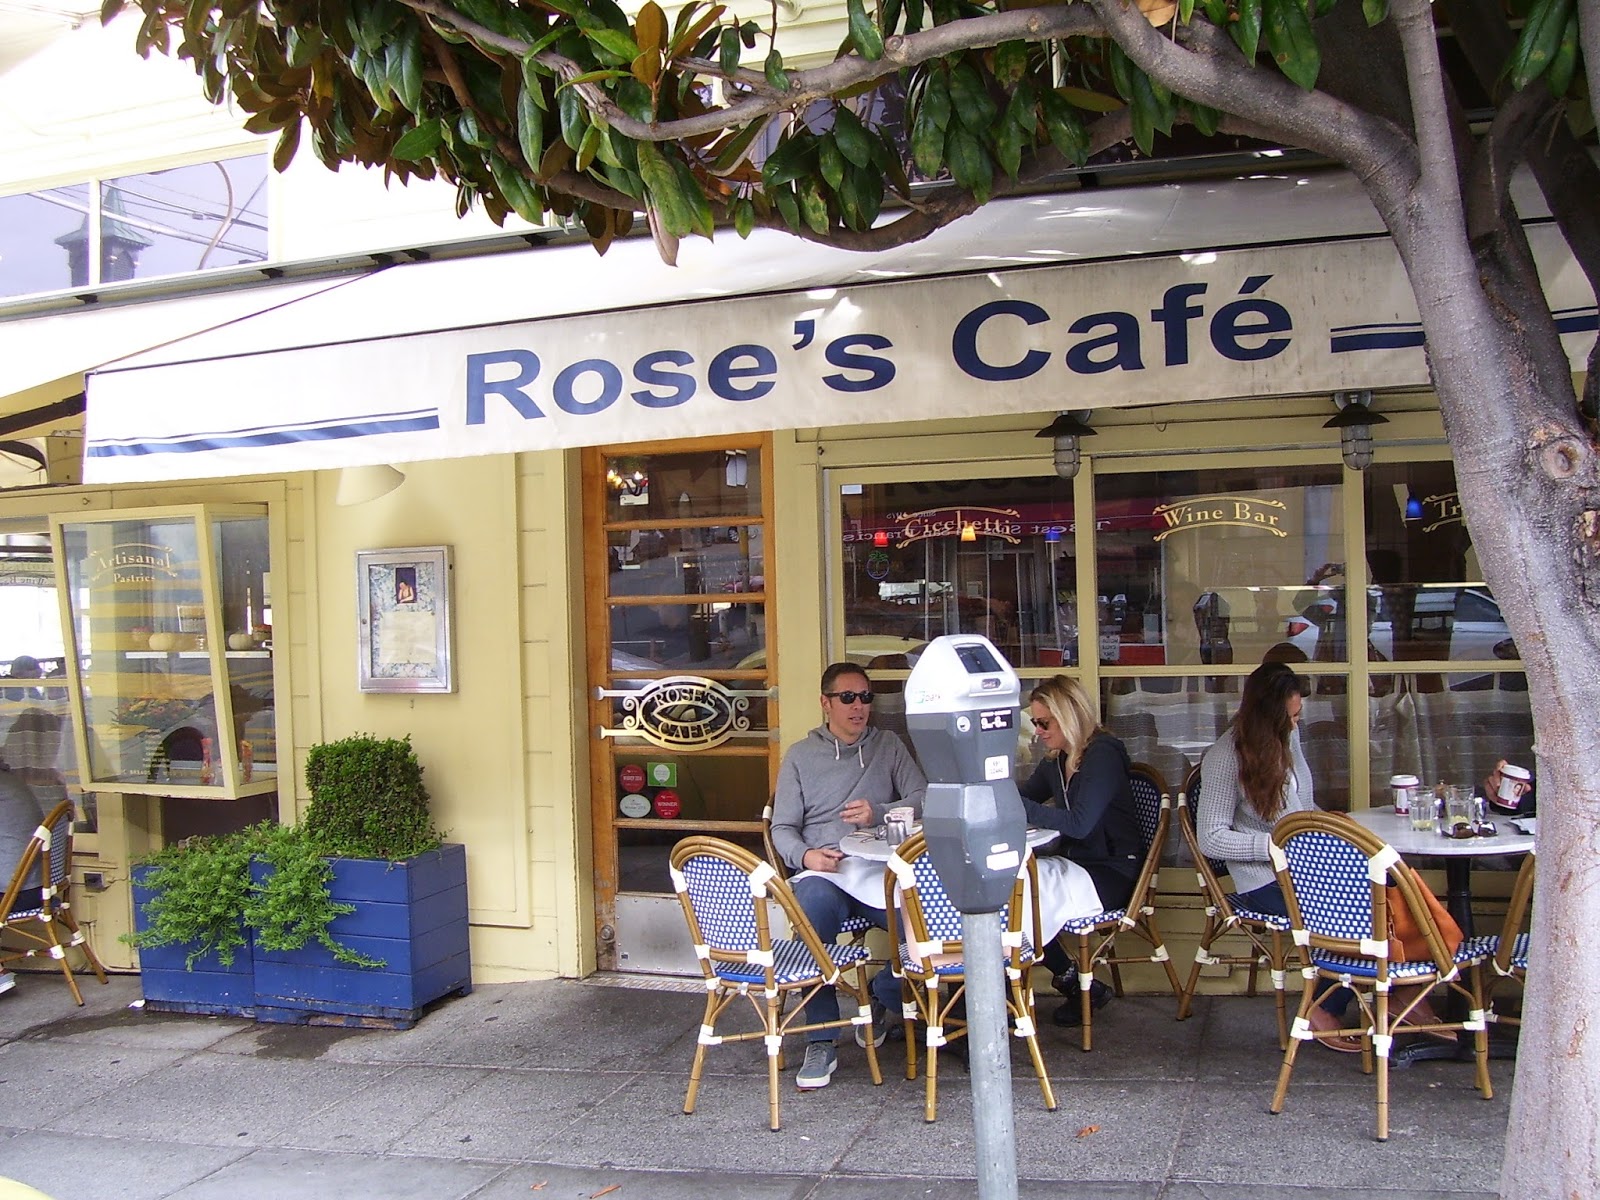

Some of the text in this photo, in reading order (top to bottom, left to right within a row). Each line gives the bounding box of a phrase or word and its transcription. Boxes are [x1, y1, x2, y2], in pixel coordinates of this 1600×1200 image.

[466, 274, 1293, 426] Rose's Café
[905, 510, 1010, 538] Cicchetti
[1162, 502, 1279, 527] Wine Bar
[97, 551, 170, 572] Artisanal
[113, 573, 155, 583] Pastries
[658, 721, 713, 738] CAFE
